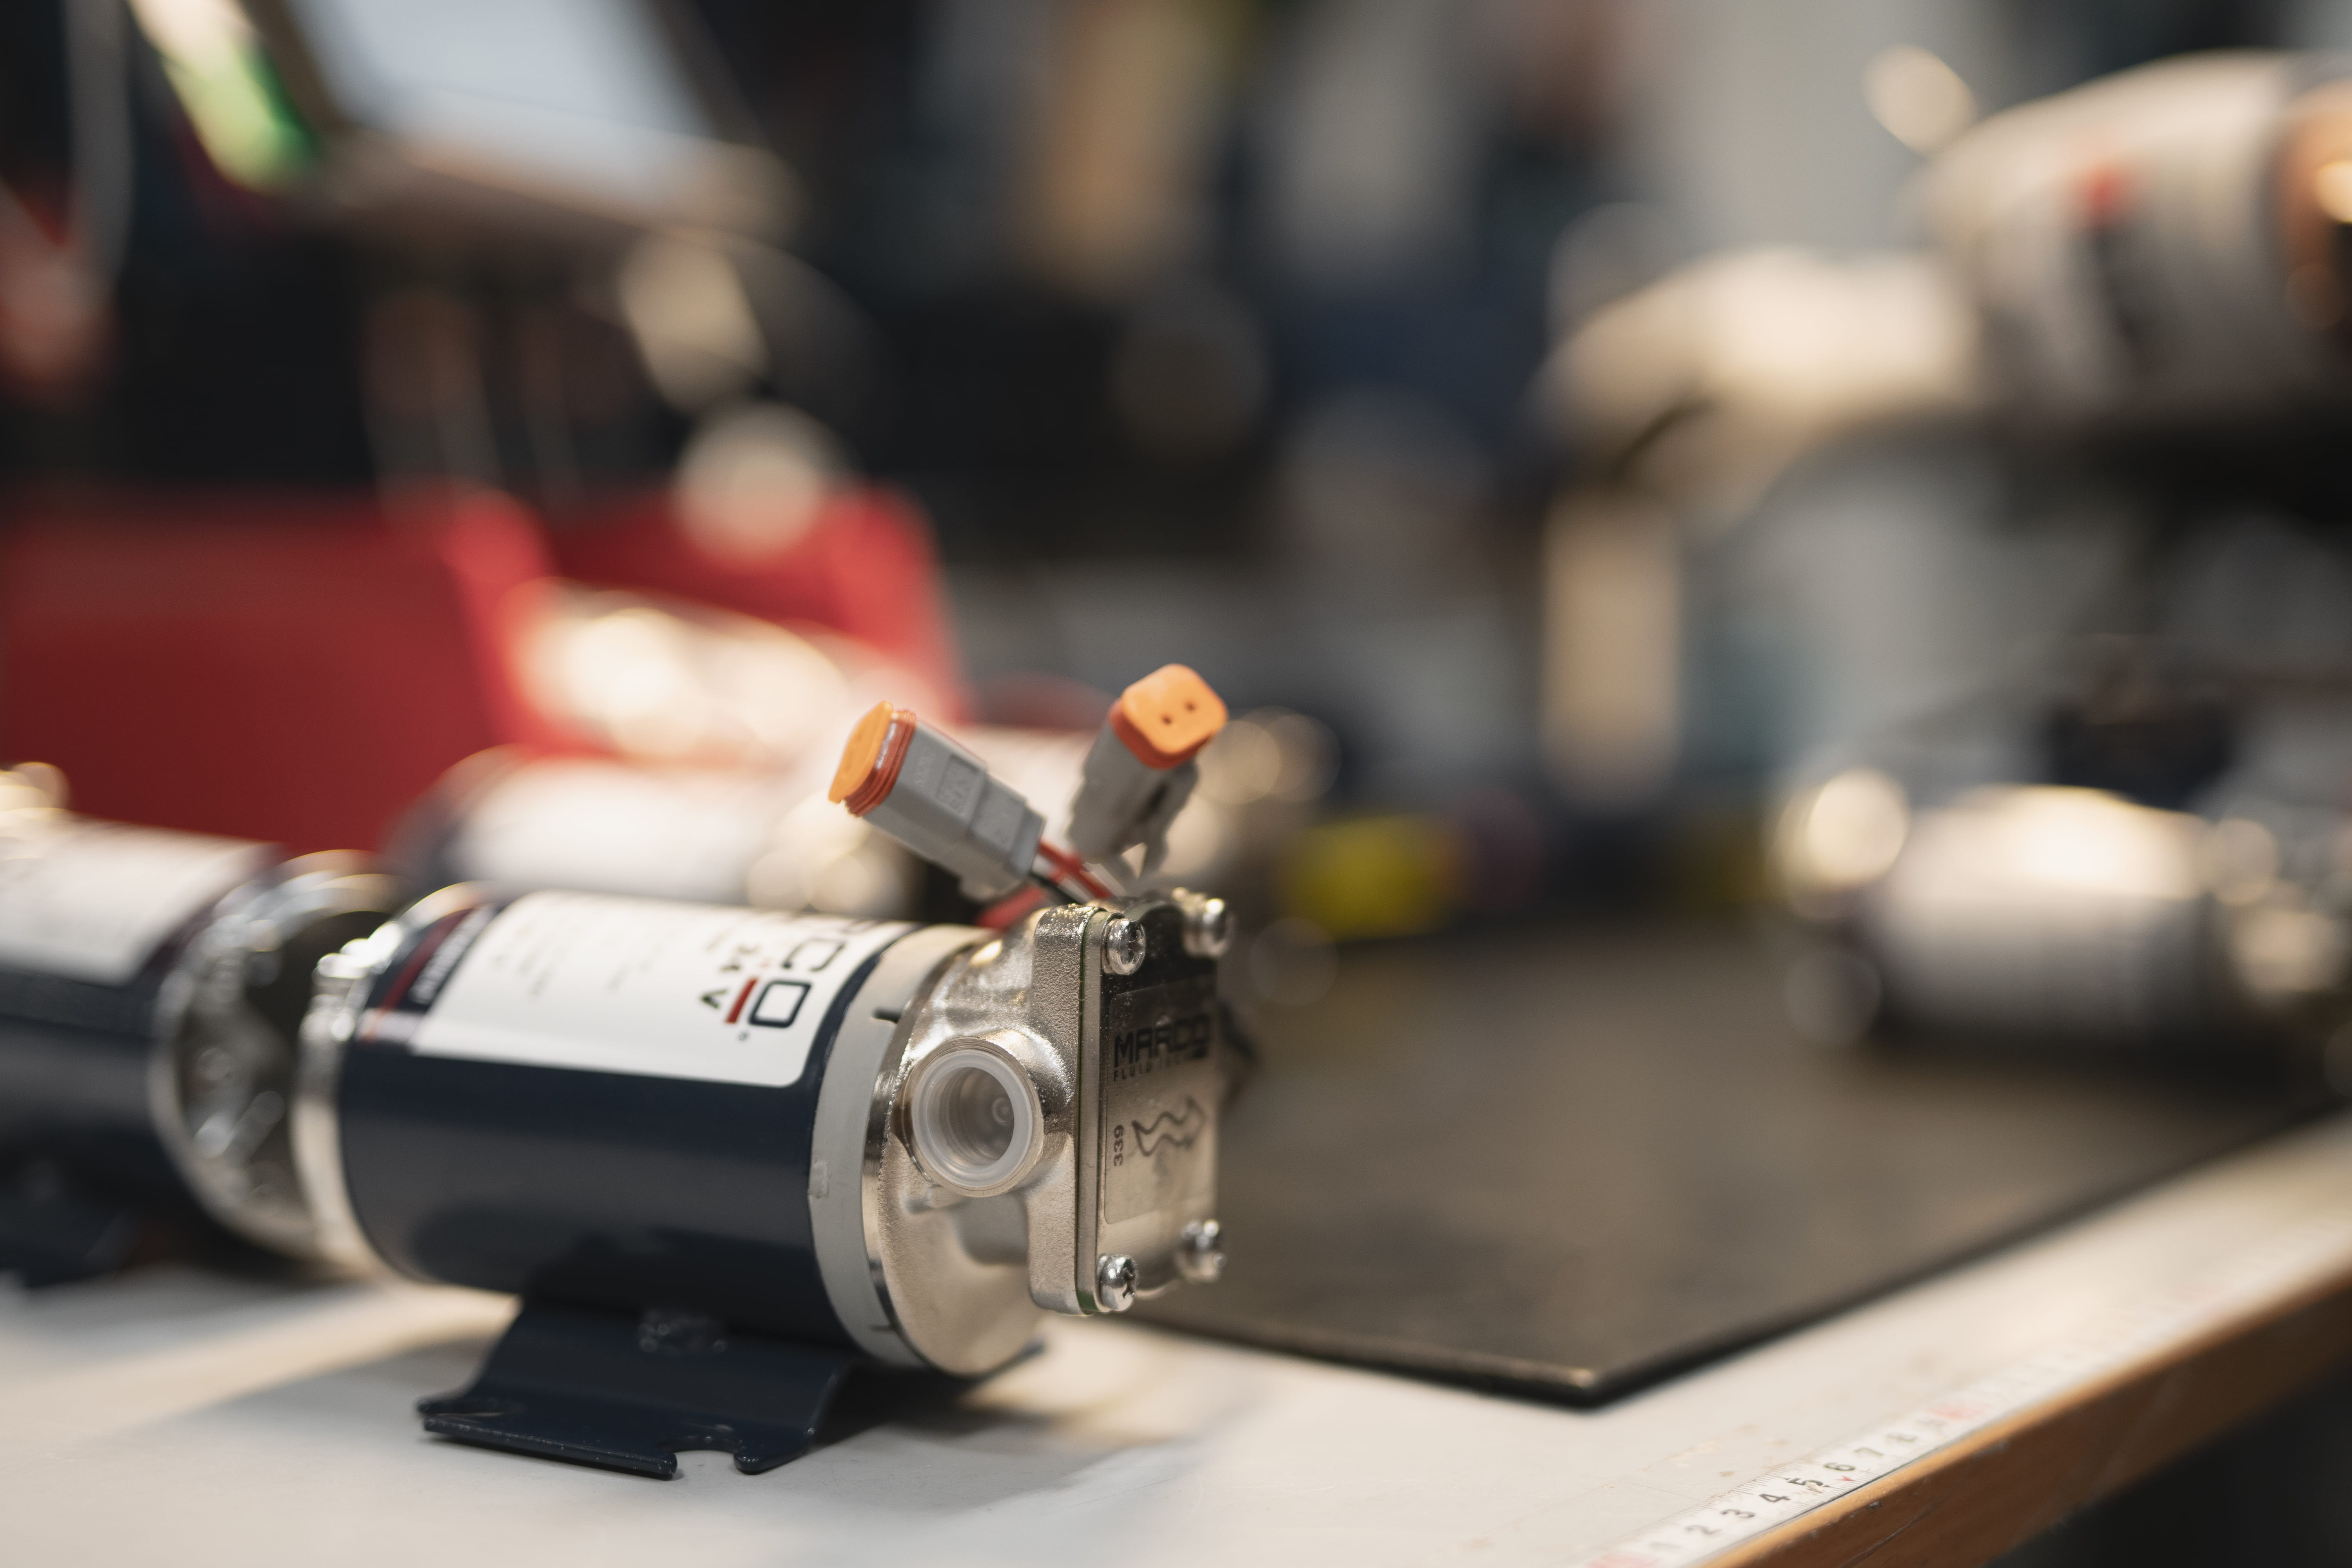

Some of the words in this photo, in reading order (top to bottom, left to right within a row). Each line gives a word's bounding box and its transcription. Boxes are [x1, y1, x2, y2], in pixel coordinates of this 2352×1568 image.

[1114, 1062, 1152, 1082] FLUID
[1114, 1124, 1124, 1167] 339
[1684, 1524, 1722, 1535] 2
[1720, 1508, 1756, 1519] 3
[1759, 1493, 1791, 1503] 4
[1787, 1477, 1825, 1488] 5
[1823, 1462, 1856, 1472] 6
[1853, 1446, 1885, 1457] 7
